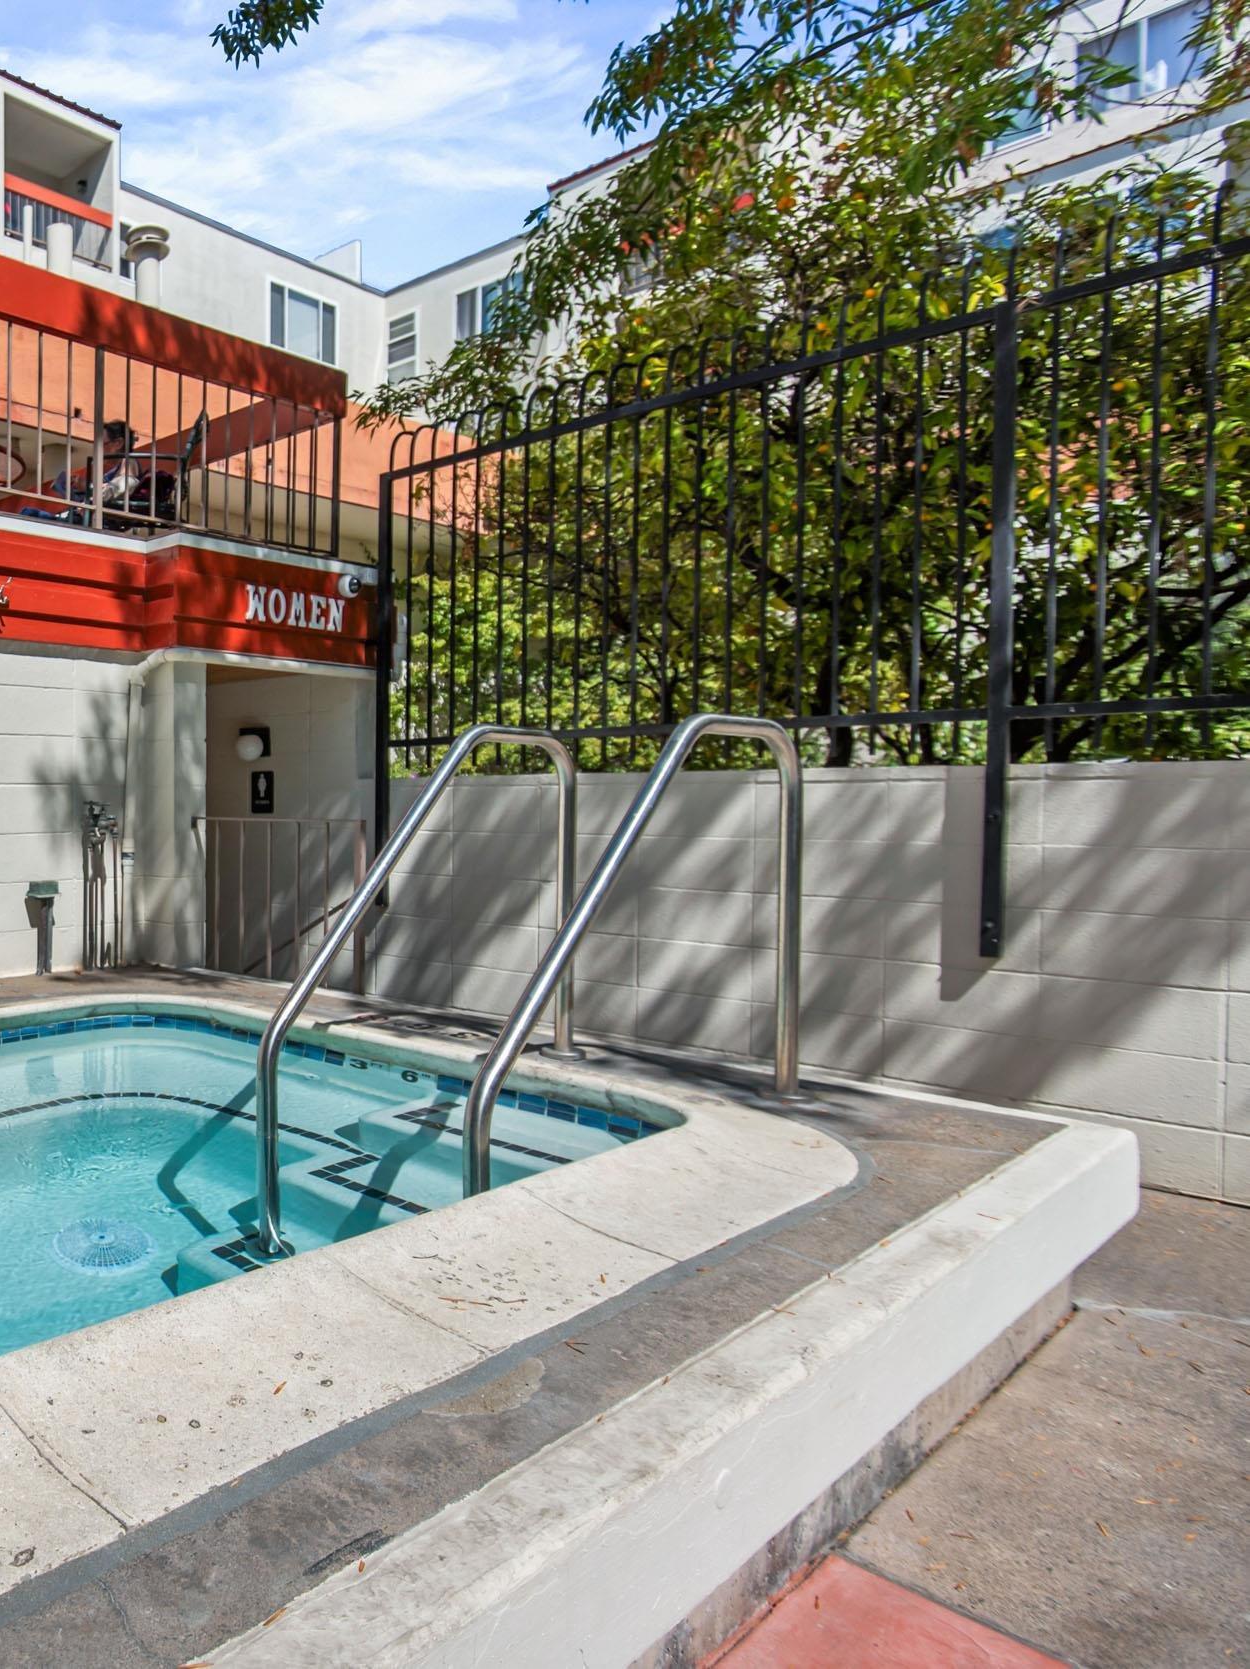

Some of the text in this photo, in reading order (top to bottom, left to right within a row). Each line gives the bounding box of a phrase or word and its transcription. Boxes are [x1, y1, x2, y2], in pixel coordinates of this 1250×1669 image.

[245, 584, 346, 633] WOMEN
[350, 1058, 368, 1070] 3
[402, 1070, 419, 1083] 6
